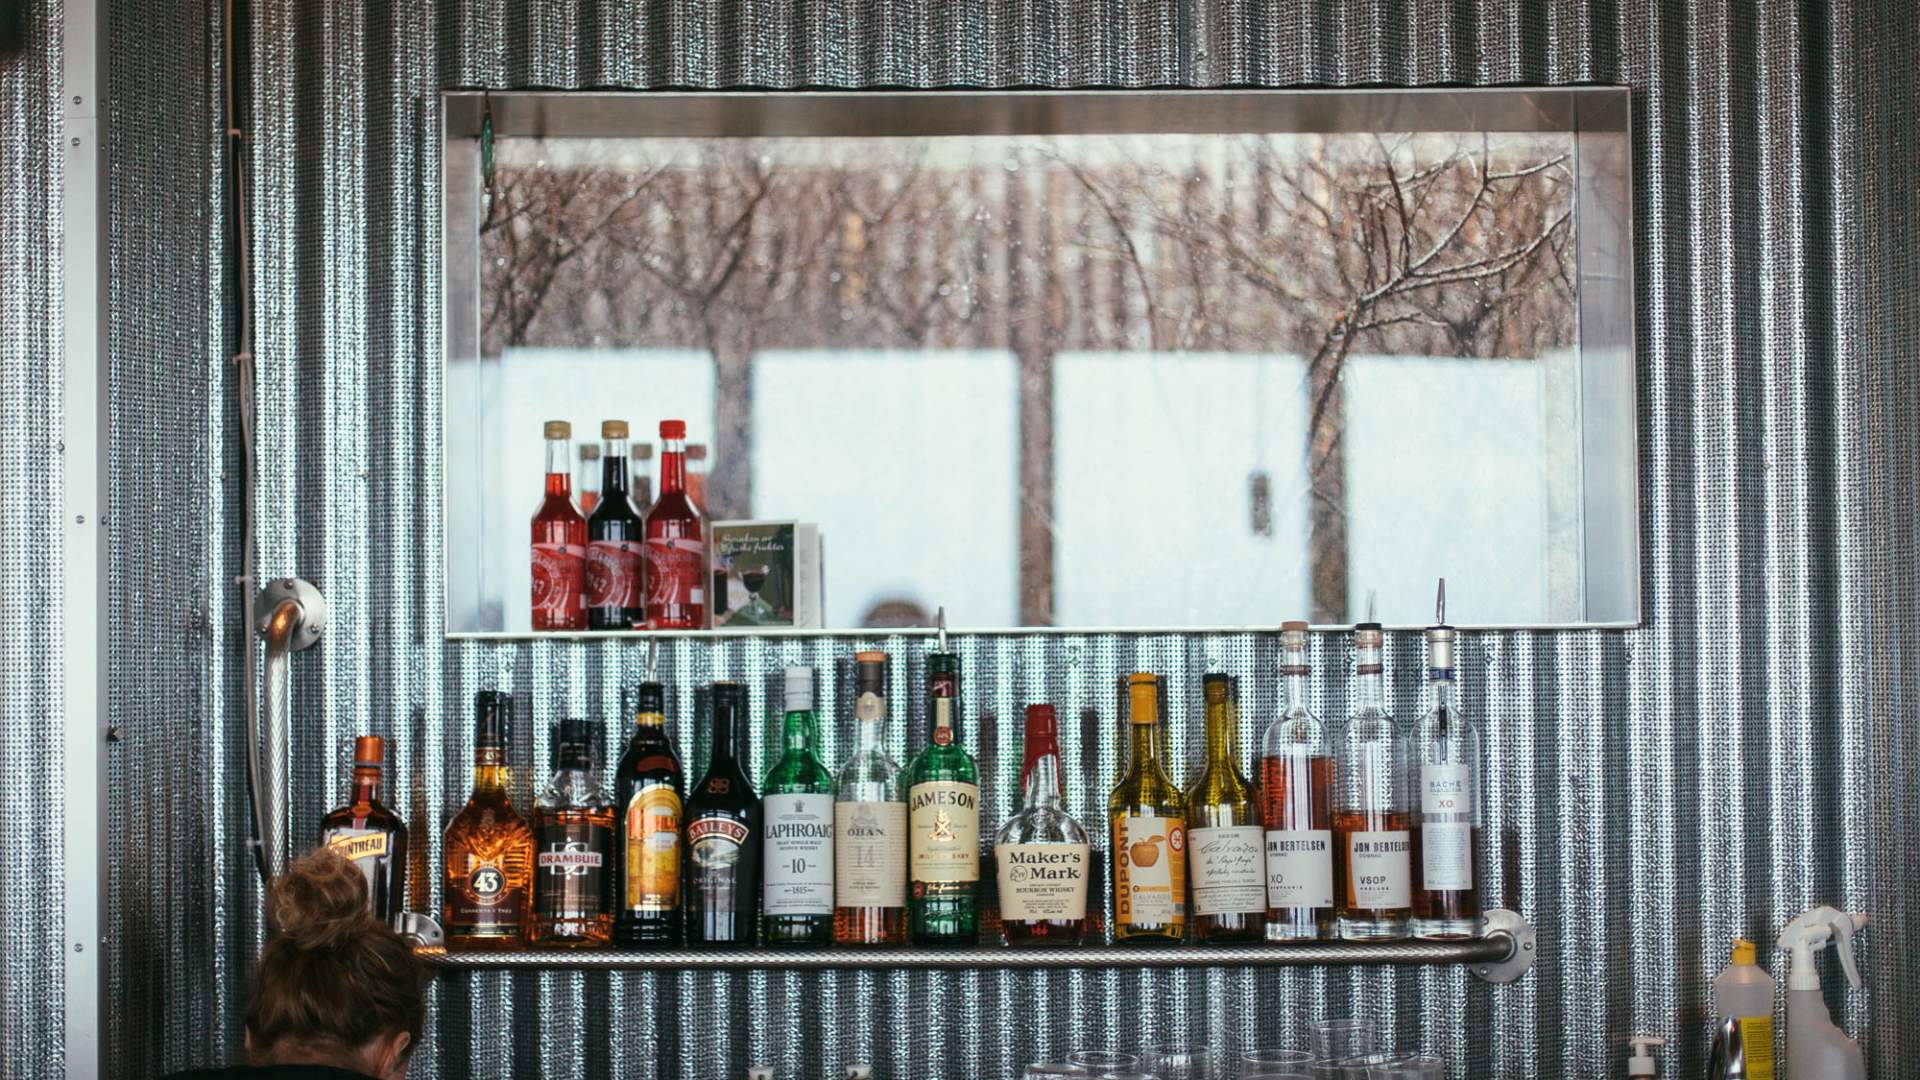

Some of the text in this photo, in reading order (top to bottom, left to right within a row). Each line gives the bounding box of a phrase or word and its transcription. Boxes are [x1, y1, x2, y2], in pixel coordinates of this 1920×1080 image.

[911, 790, 975, 812] JAMESON
[1438, 799, 1454, 808] XO
[689, 820, 746, 841] BAILEYS
[847, 828, 884, 837] OBAN
[1280, 840, 1326, 851] BERTELSEN
[1354, 842, 1370, 853] JON
[540, 852, 601, 865] DRAMBUIE
[1009, 851, 1081, 864] Maker's
[791, 858, 806, 874] 10
[1119, 823, 1130, 915] DUPONT
[1030, 867, 1081, 880] Mark
[1270, 873, 1283, 884] XO
[473, 872, 498, 893] 43
[1359, 876, 1386, 885] VSOP
